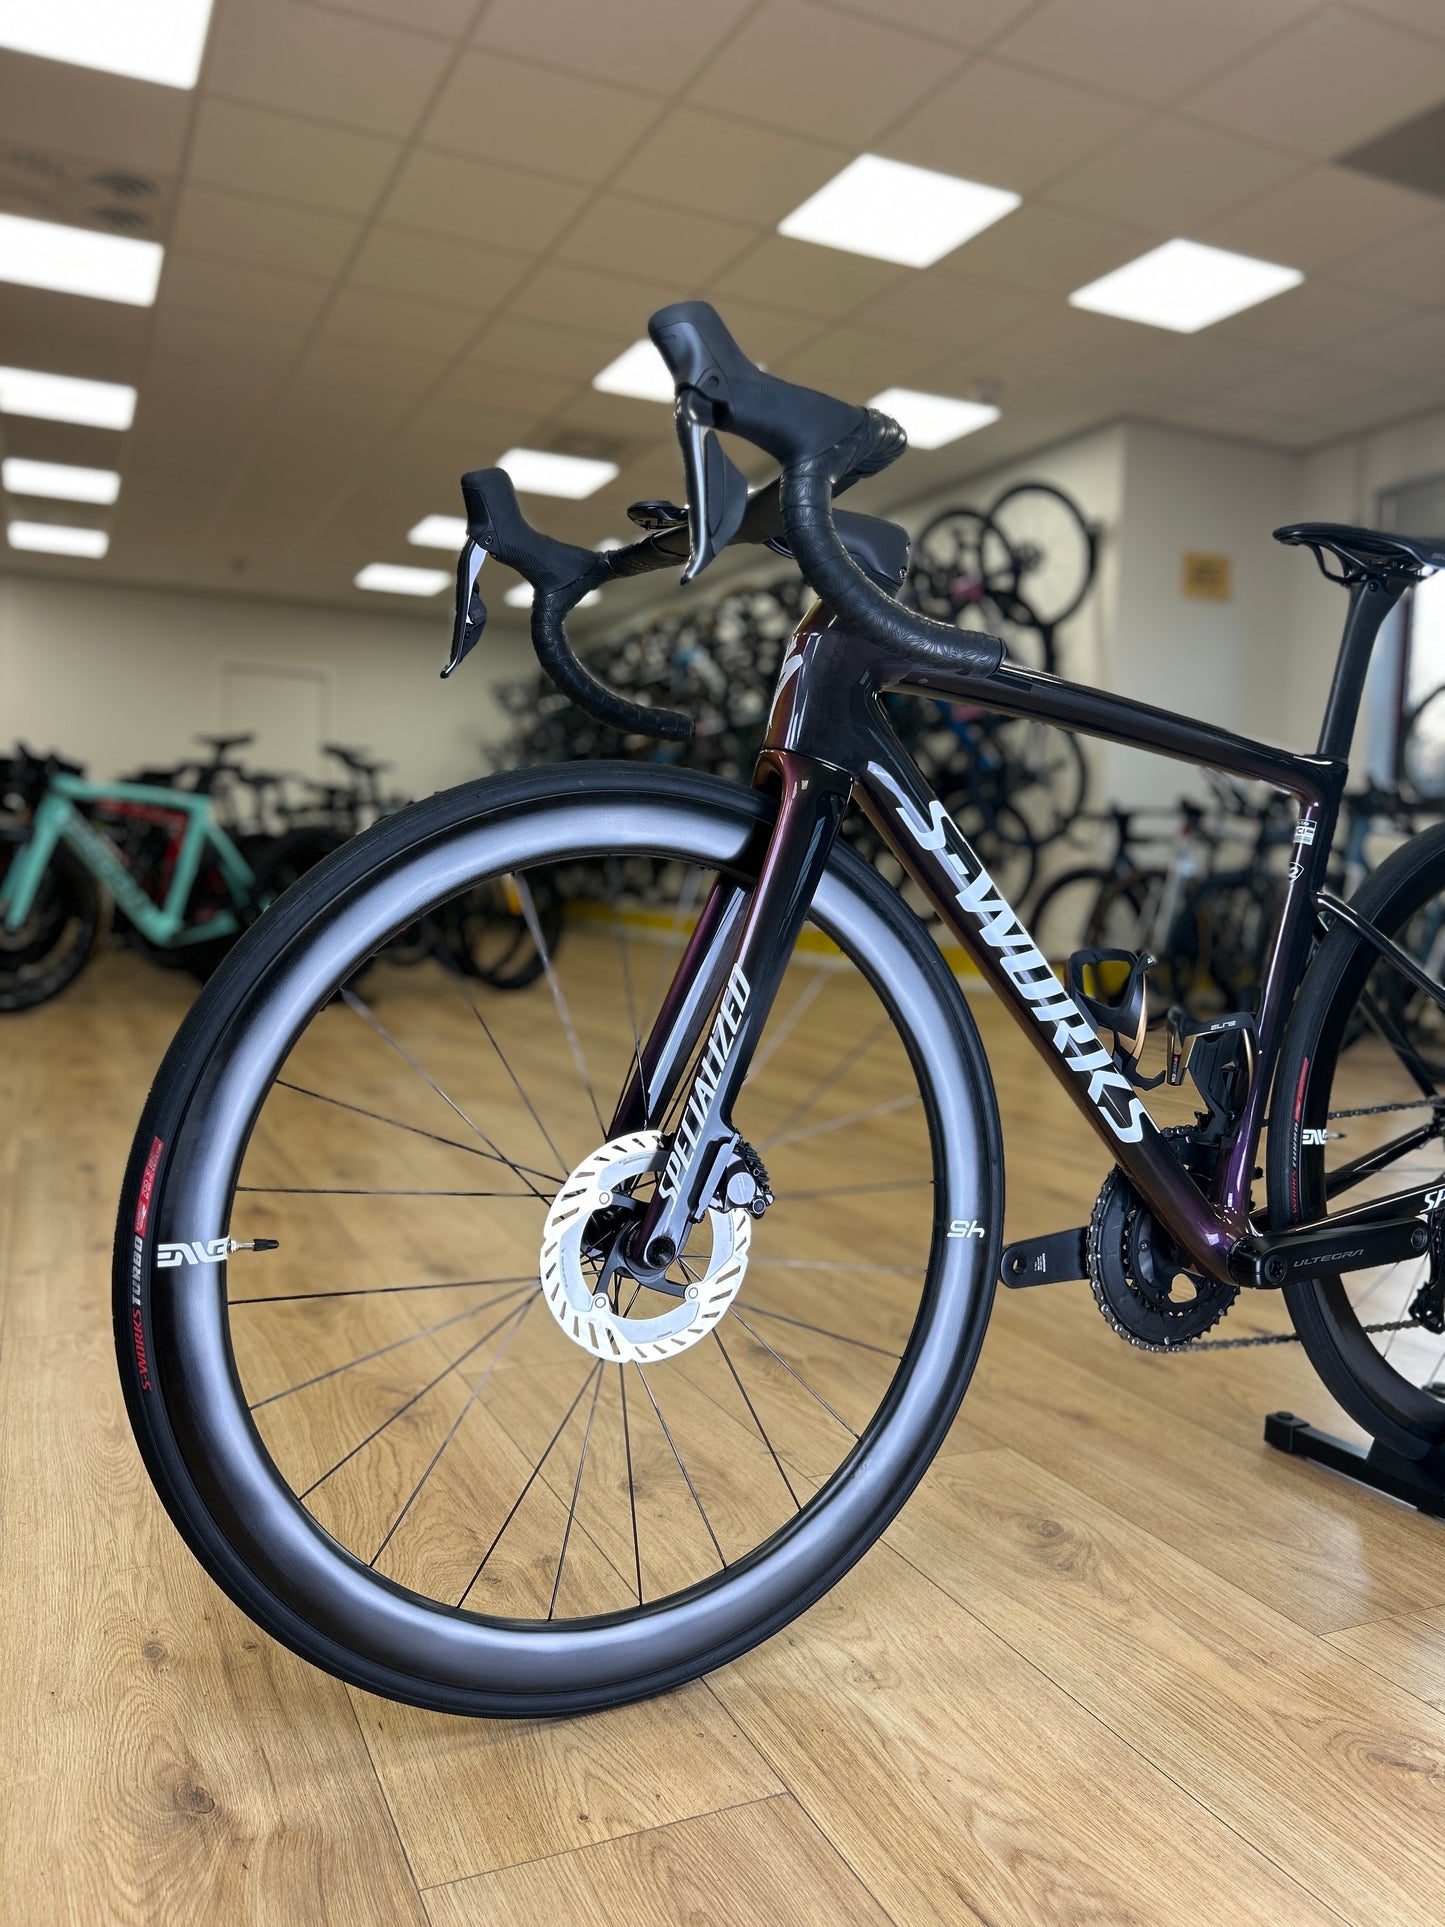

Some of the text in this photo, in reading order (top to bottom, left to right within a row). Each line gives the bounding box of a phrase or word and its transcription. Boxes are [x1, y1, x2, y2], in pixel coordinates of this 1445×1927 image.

[895, 800, 1144, 1143] S-WORKS
[658, 962, 751, 1216] SPECIALIZED
[132, 1235, 143, 1306] TURBO
[1294, 1249, 1365, 1268] ULTEGRA
[132, 1307, 152, 1391] S-WORKS
